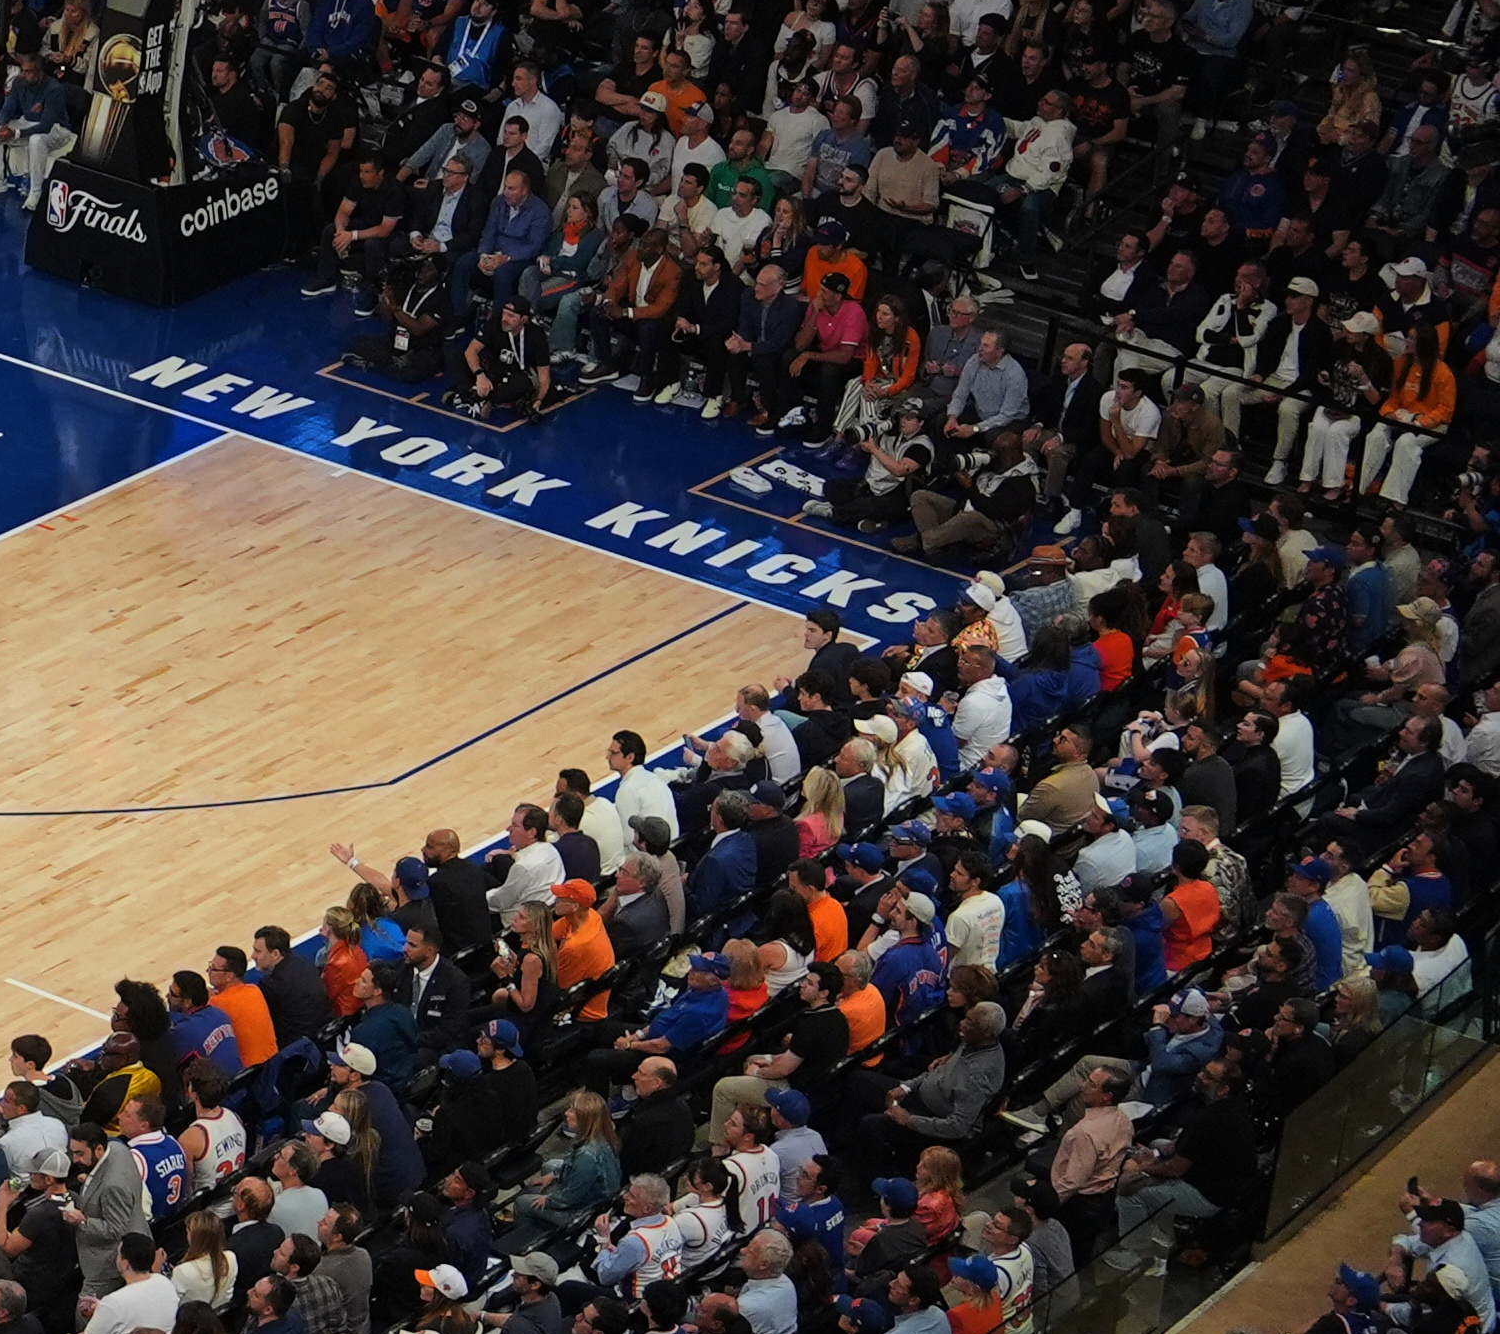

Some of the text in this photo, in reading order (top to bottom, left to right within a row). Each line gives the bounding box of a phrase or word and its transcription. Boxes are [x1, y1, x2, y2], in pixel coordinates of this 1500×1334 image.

[146, 23, 164, 49] GET
[144, 46, 162, 71] THE
[68, 186, 147, 243] Finals
[180, 177, 278, 237] coinbase
[129, 356, 938, 625] NEW YORK KNICKS
[167, 1174, 182, 1205] 3
